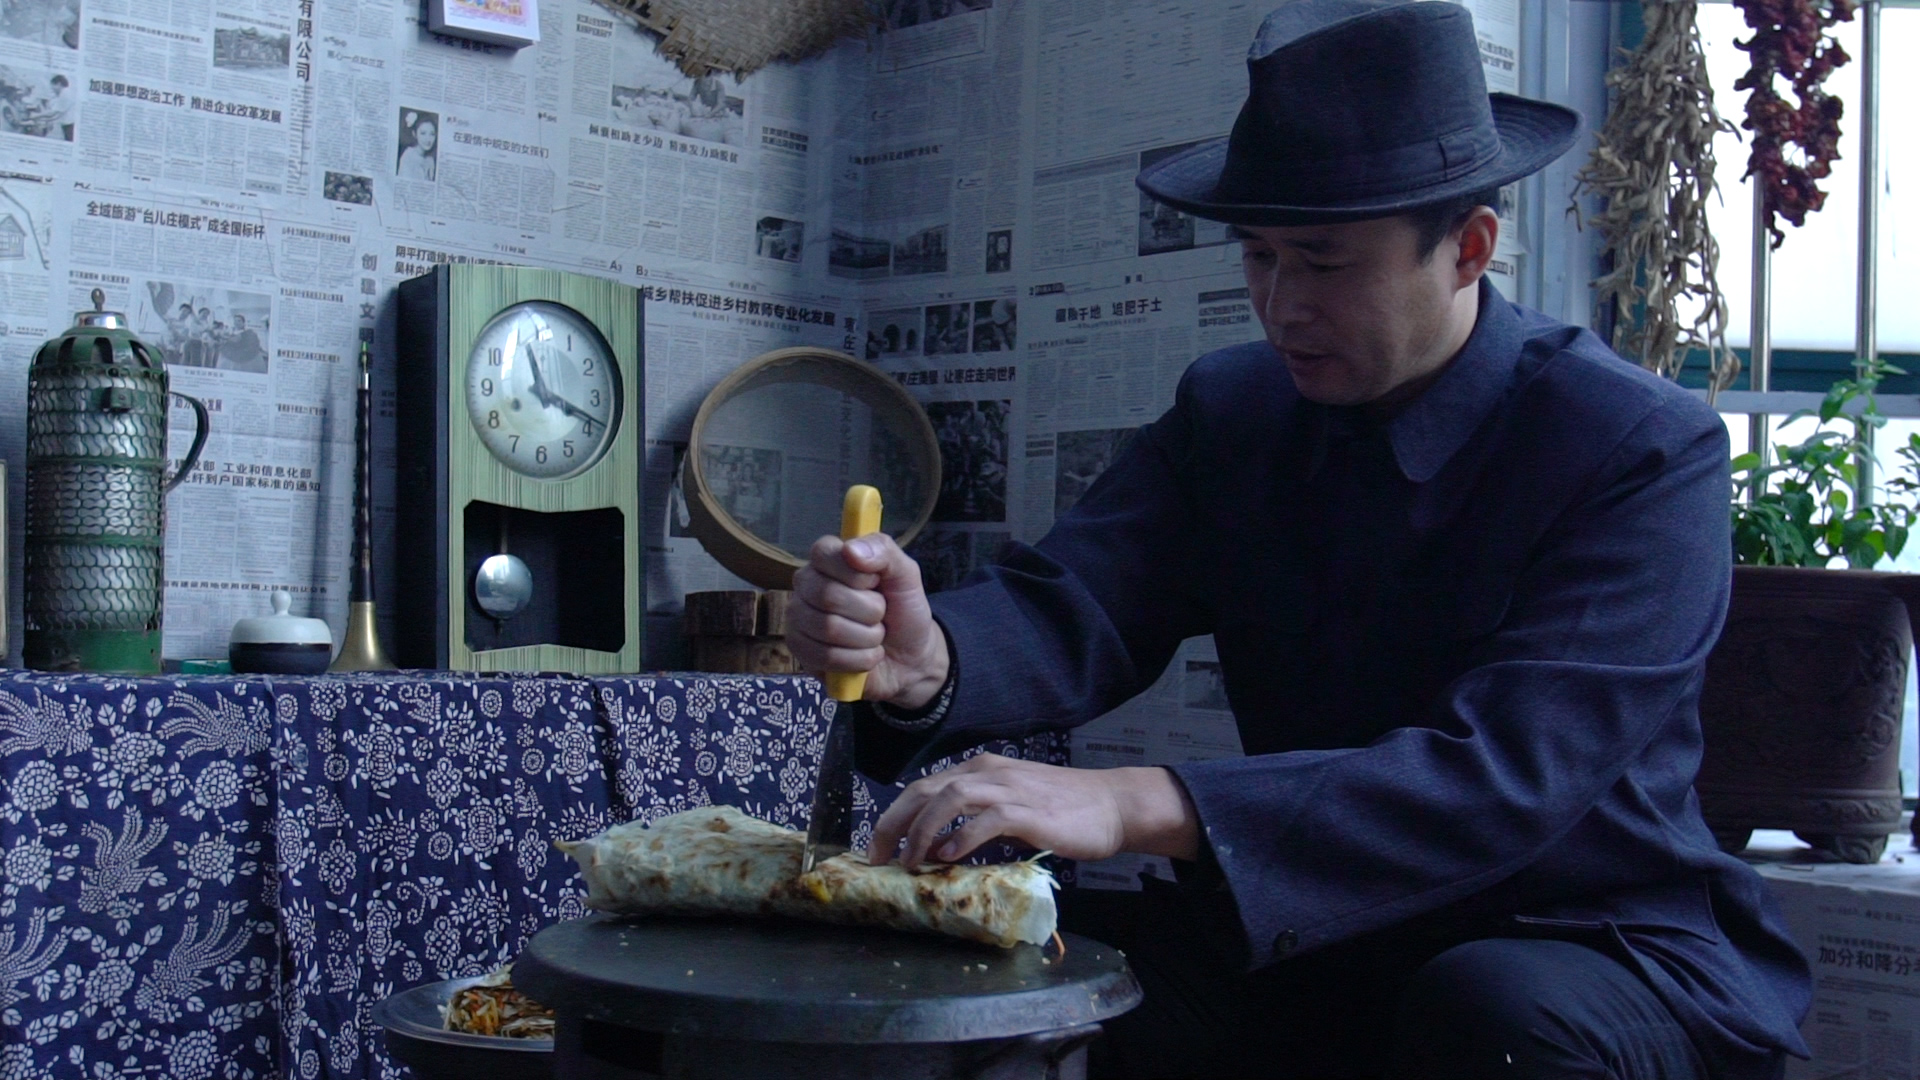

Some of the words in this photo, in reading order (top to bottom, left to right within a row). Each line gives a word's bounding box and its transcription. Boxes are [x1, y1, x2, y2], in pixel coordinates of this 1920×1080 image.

[296, 0, 315, 83] 有限公司
[89, 78, 185, 108] 加强思想政治工作
[190, 95, 282, 124] 推进企业改革发展
[636, 265, 649, 277] B2
[566, 334, 572, 352] 1
[487, 347, 502, 367] 10
[583, 357, 594, 377] 2
[480, 378, 493, 397] 9
[589, 389, 600, 408] 3
[487, 410, 500, 429] 8
[582, 418, 593, 438] 4
[508, 434, 521, 453] 7
[563, 440, 574, 458] 5
[535, 445, 548, 464] 6
[223, 462, 312, 479] 工业和信息化部
[1818, 946, 1920, 976] 加分和降分
